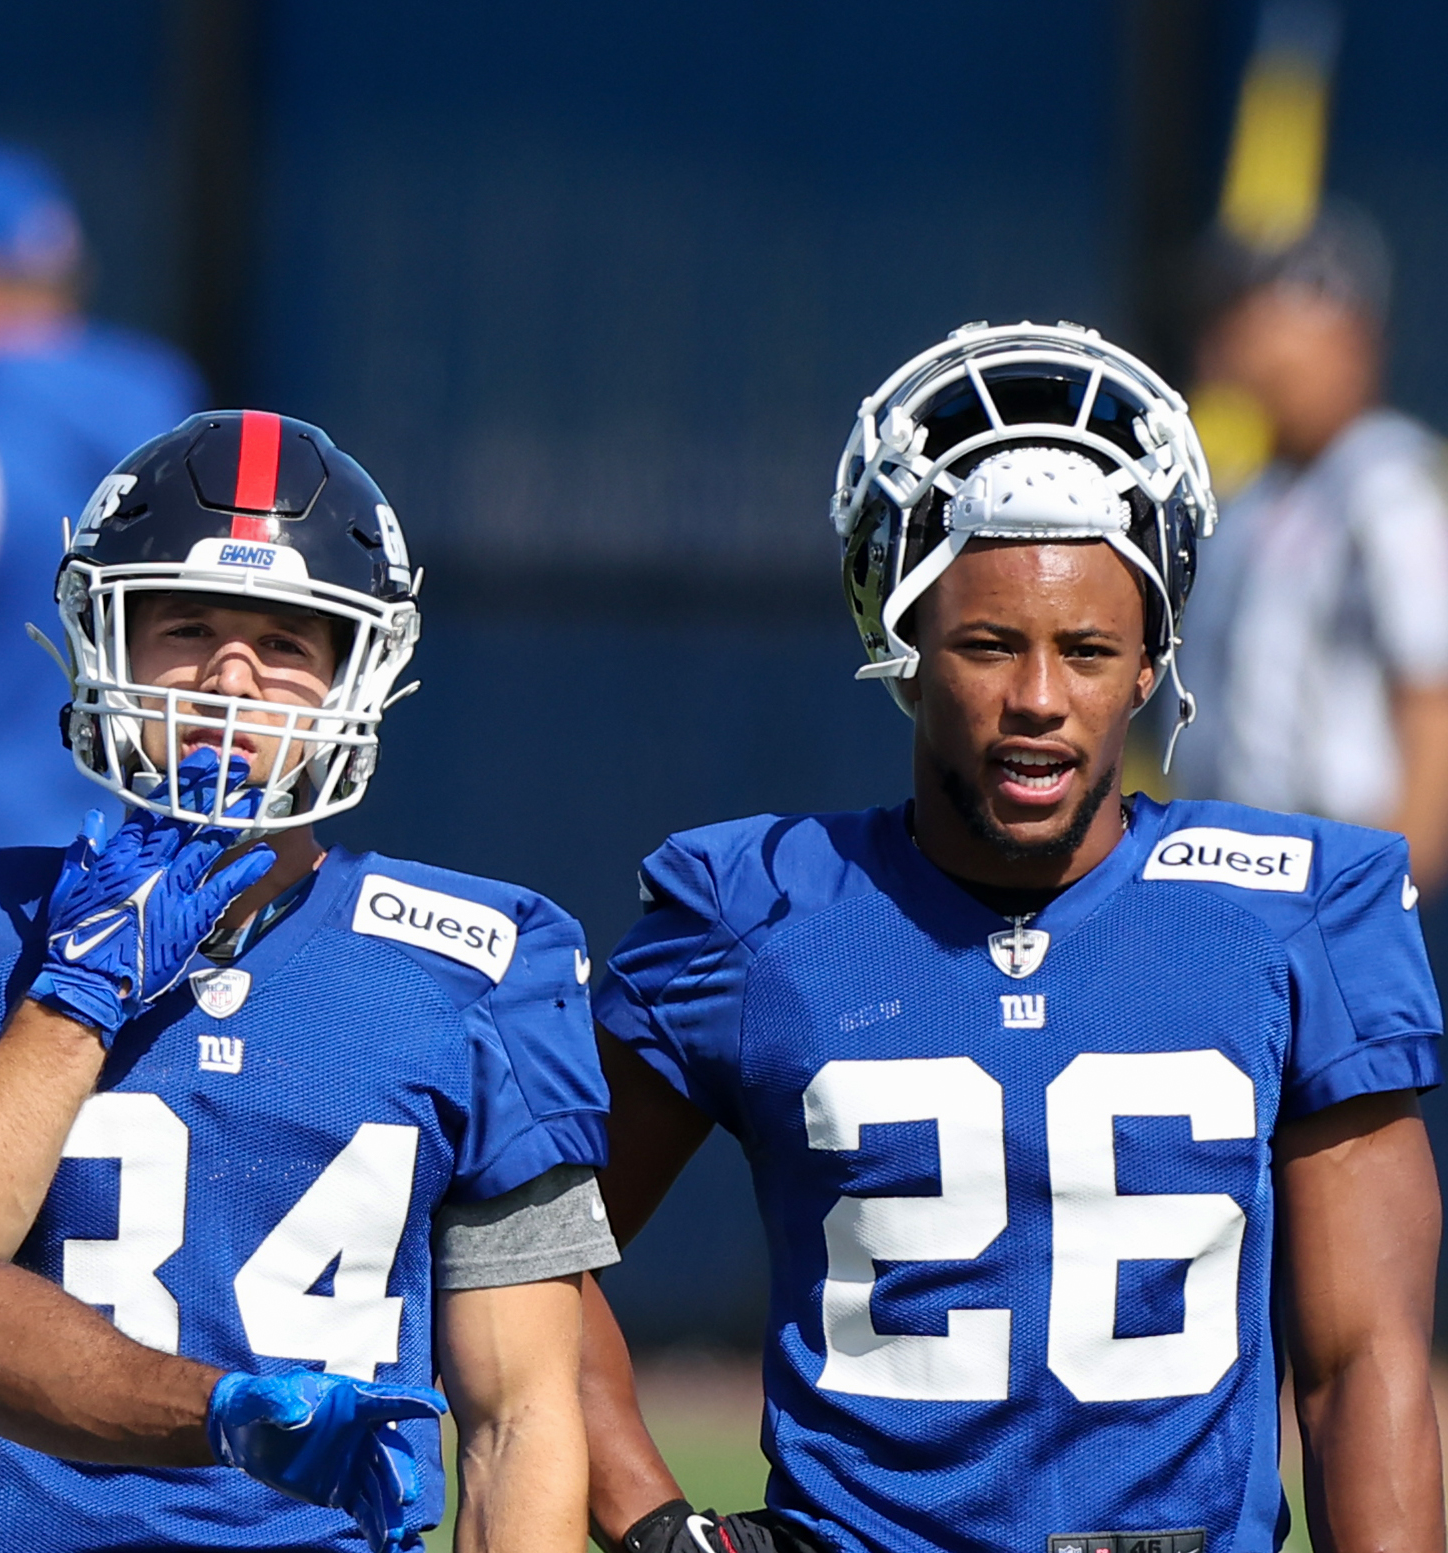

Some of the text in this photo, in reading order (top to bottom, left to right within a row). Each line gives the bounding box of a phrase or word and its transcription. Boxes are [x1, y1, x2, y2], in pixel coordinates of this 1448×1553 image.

[219, 544, 276, 566] GIANTS
[1157, 841, 1293, 877] Quest
[368, 891, 500, 959] Quest
[210, 992, 233, 1006] NFL
[60, 1092, 420, 1384] 34
[803, 1048, 1257, 1403] 26
